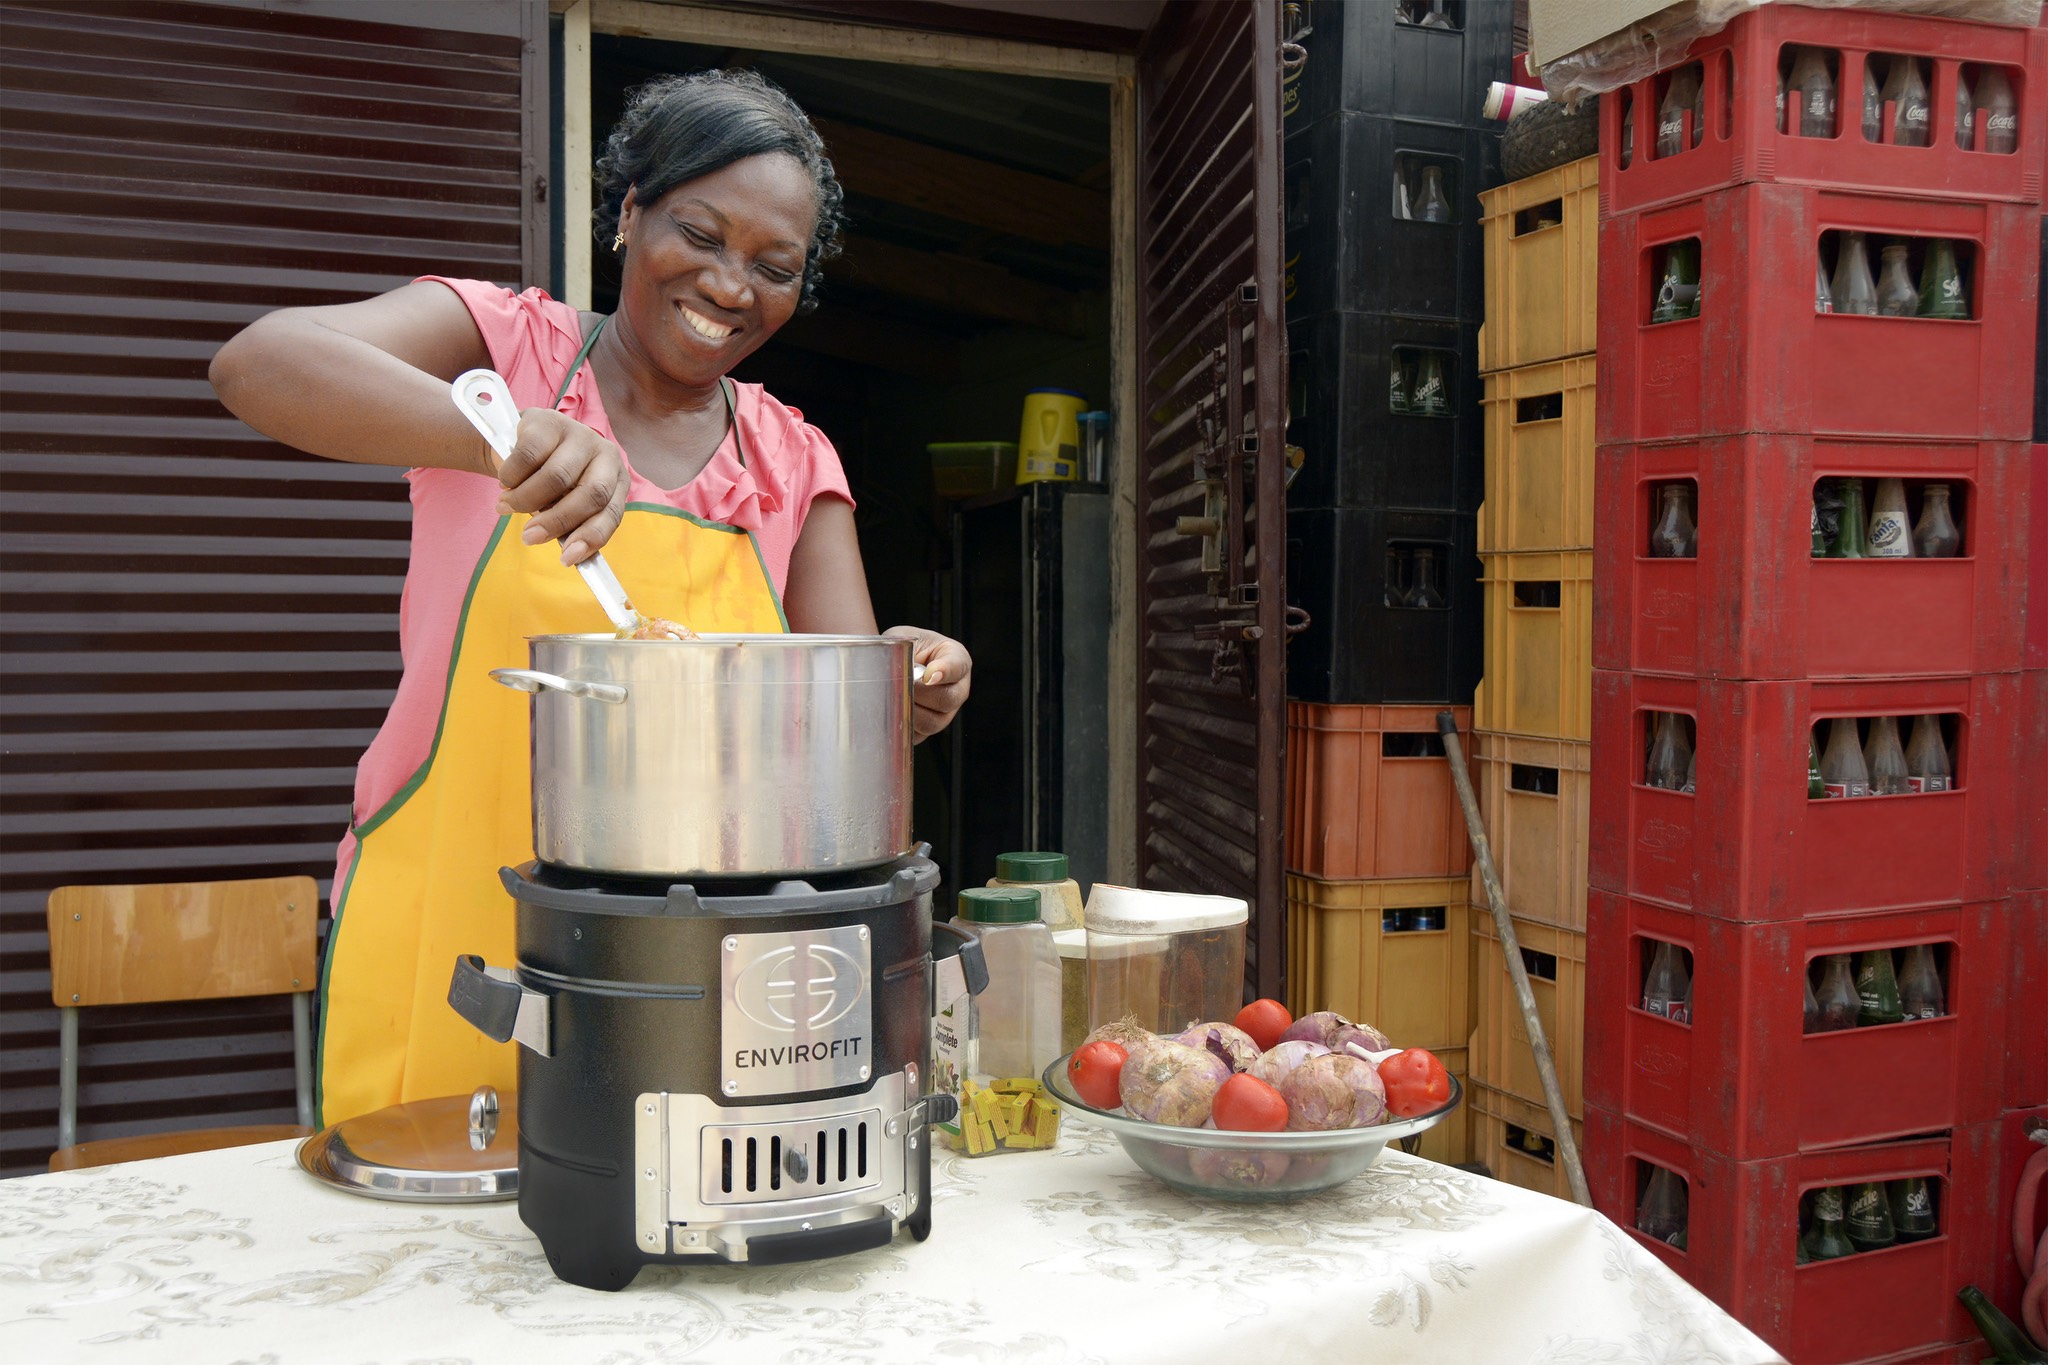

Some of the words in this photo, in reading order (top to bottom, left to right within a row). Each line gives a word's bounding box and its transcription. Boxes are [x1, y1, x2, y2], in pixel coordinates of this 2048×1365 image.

[1413, 377, 1440, 402] Sprite
[1870, 519, 1897, 545] Fanta
[935, 1026, 958, 1048] Complete
[735, 1037, 862, 1068] ENVIROFIT
